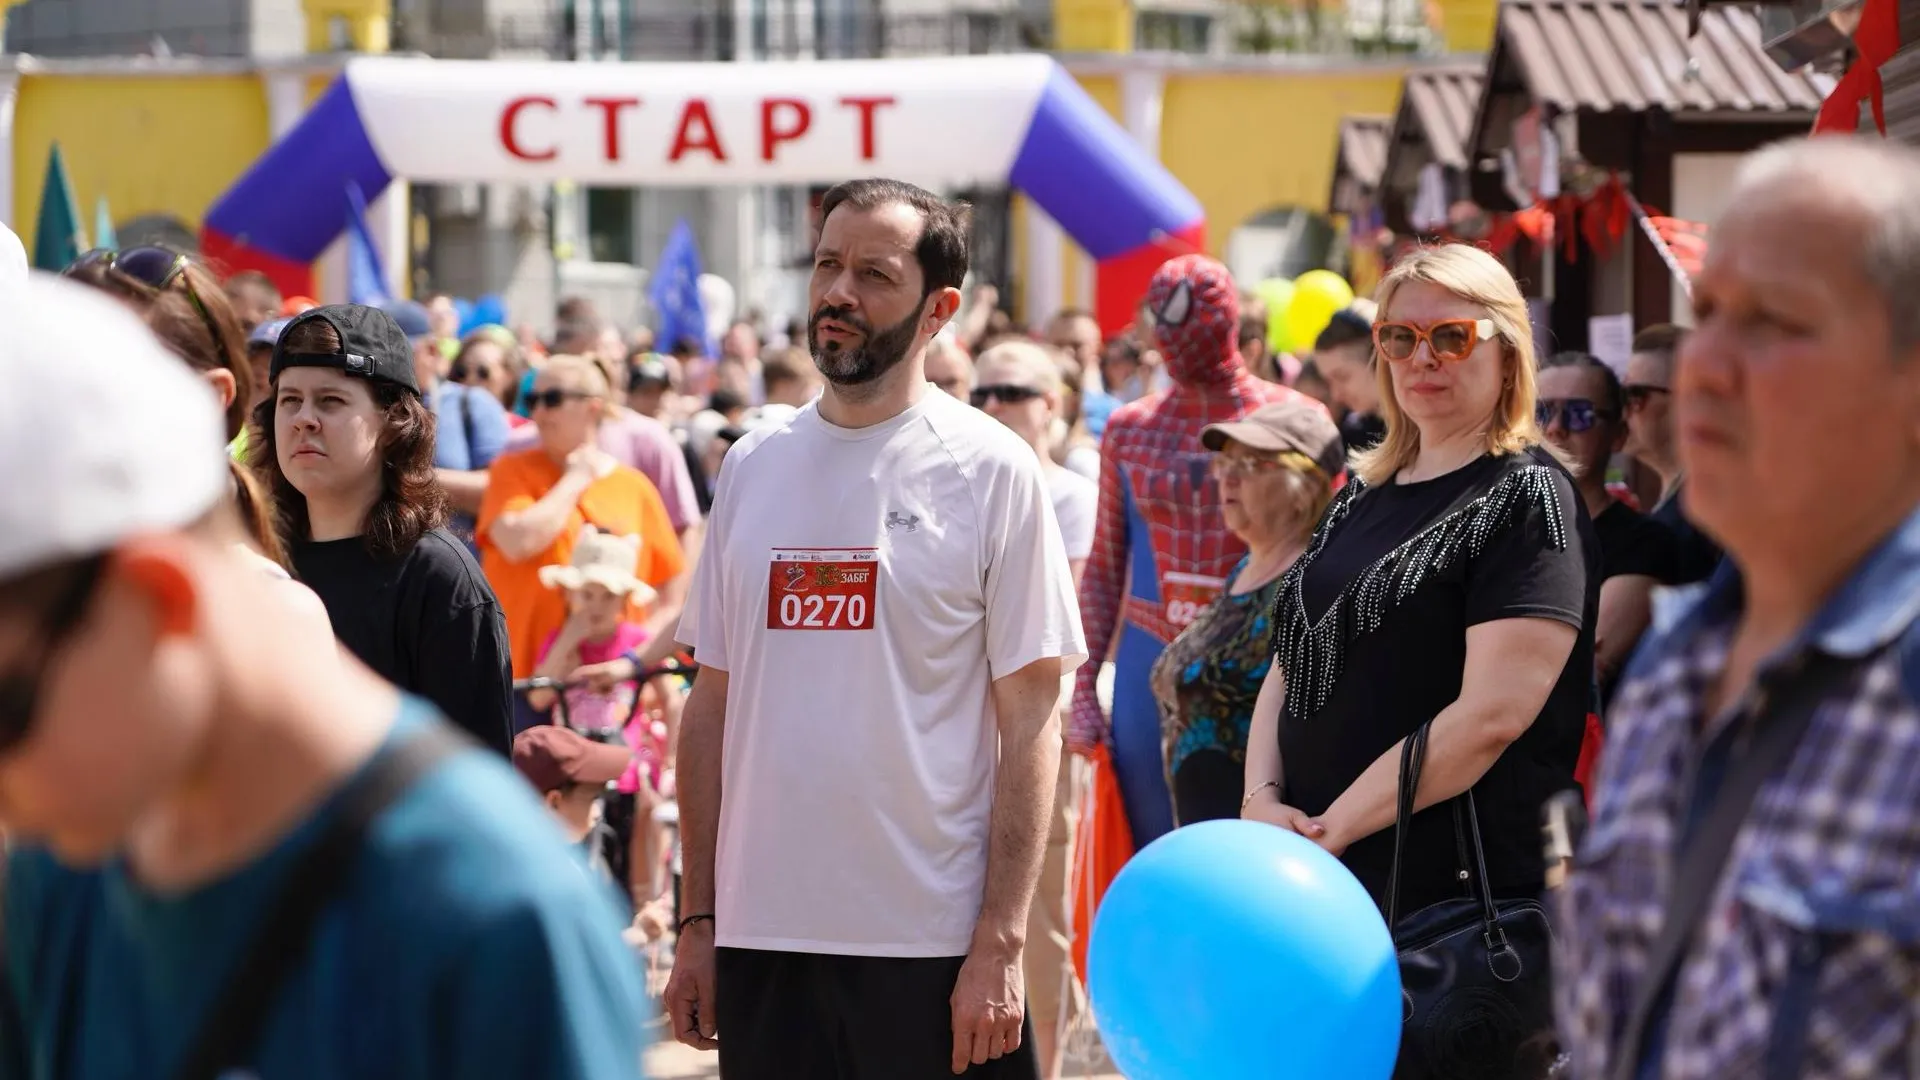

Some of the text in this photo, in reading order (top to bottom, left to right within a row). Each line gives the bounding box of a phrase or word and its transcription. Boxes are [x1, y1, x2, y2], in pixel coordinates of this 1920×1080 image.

[498, 95, 897, 162] СТАРТ
[840, 572, 869, 584] ЗАБЕГ
[780, 594, 866, 627] 0270
